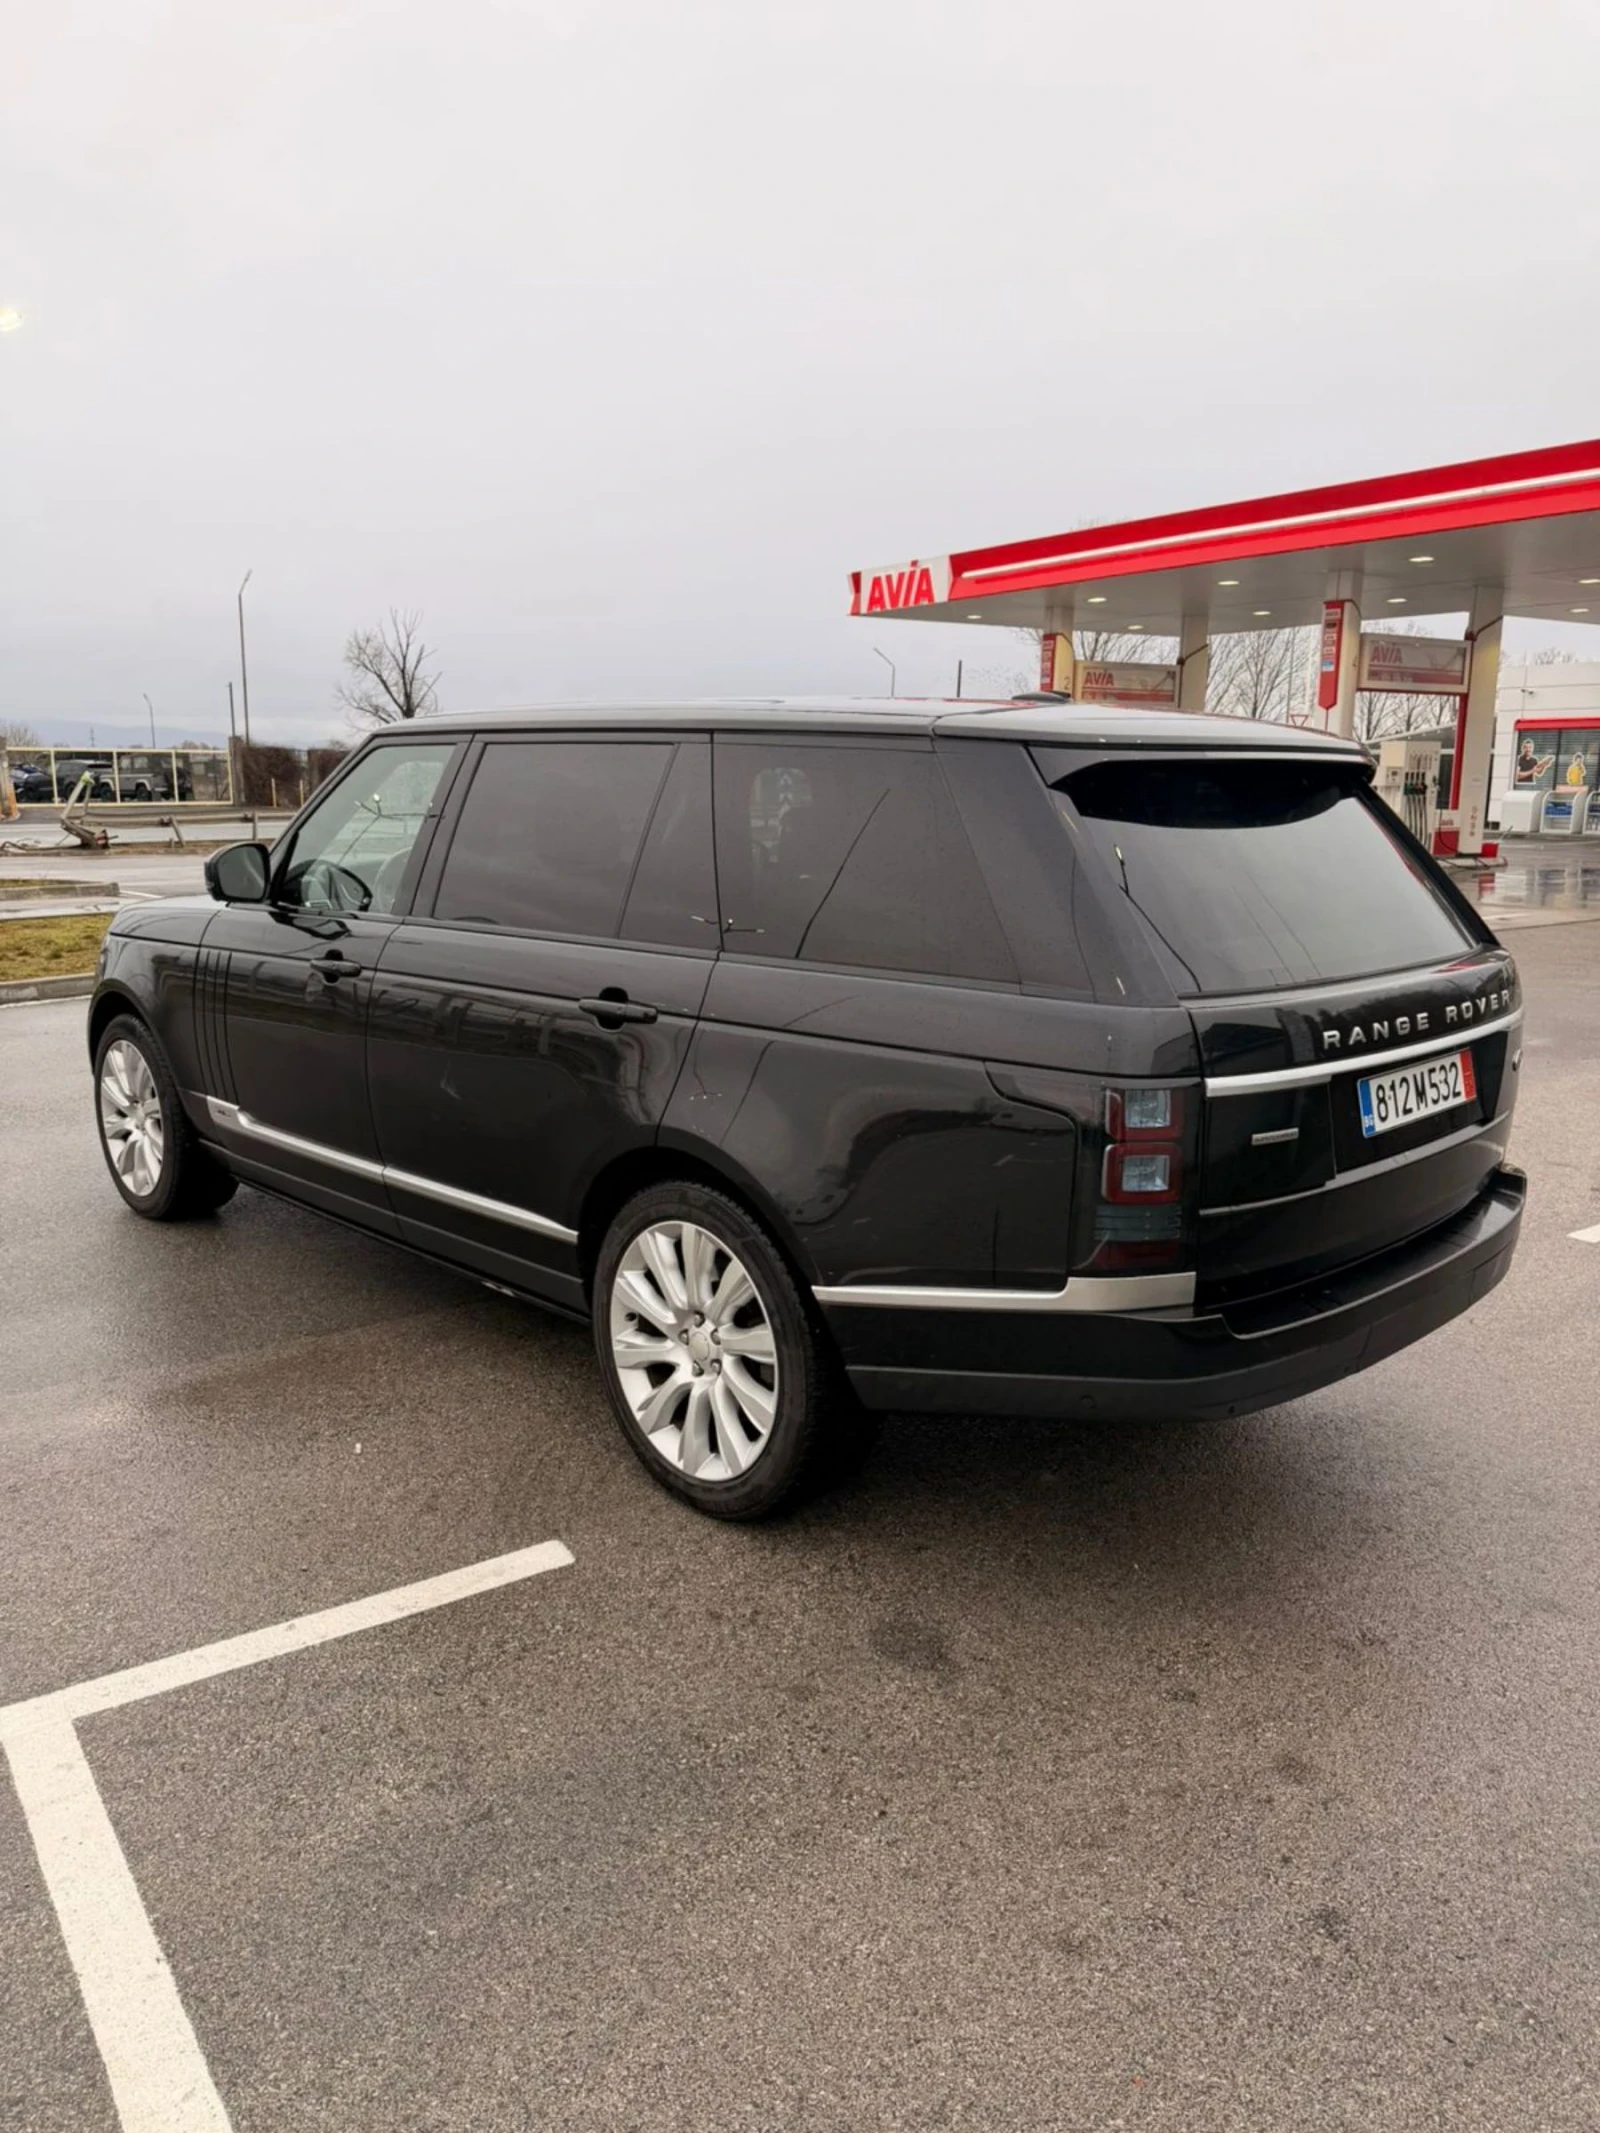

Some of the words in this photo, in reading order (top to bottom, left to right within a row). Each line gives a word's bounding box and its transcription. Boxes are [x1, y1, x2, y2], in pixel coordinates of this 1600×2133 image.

[866, 559, 935, 615] AVIA
[1085, 667, 1114, 686] AVIA
[1323, 1012, 1430, 1050] RANGE
[1446, 989, 1511, 1024] ROVER
[1375, 1061, 1462, 1123] 812M532
